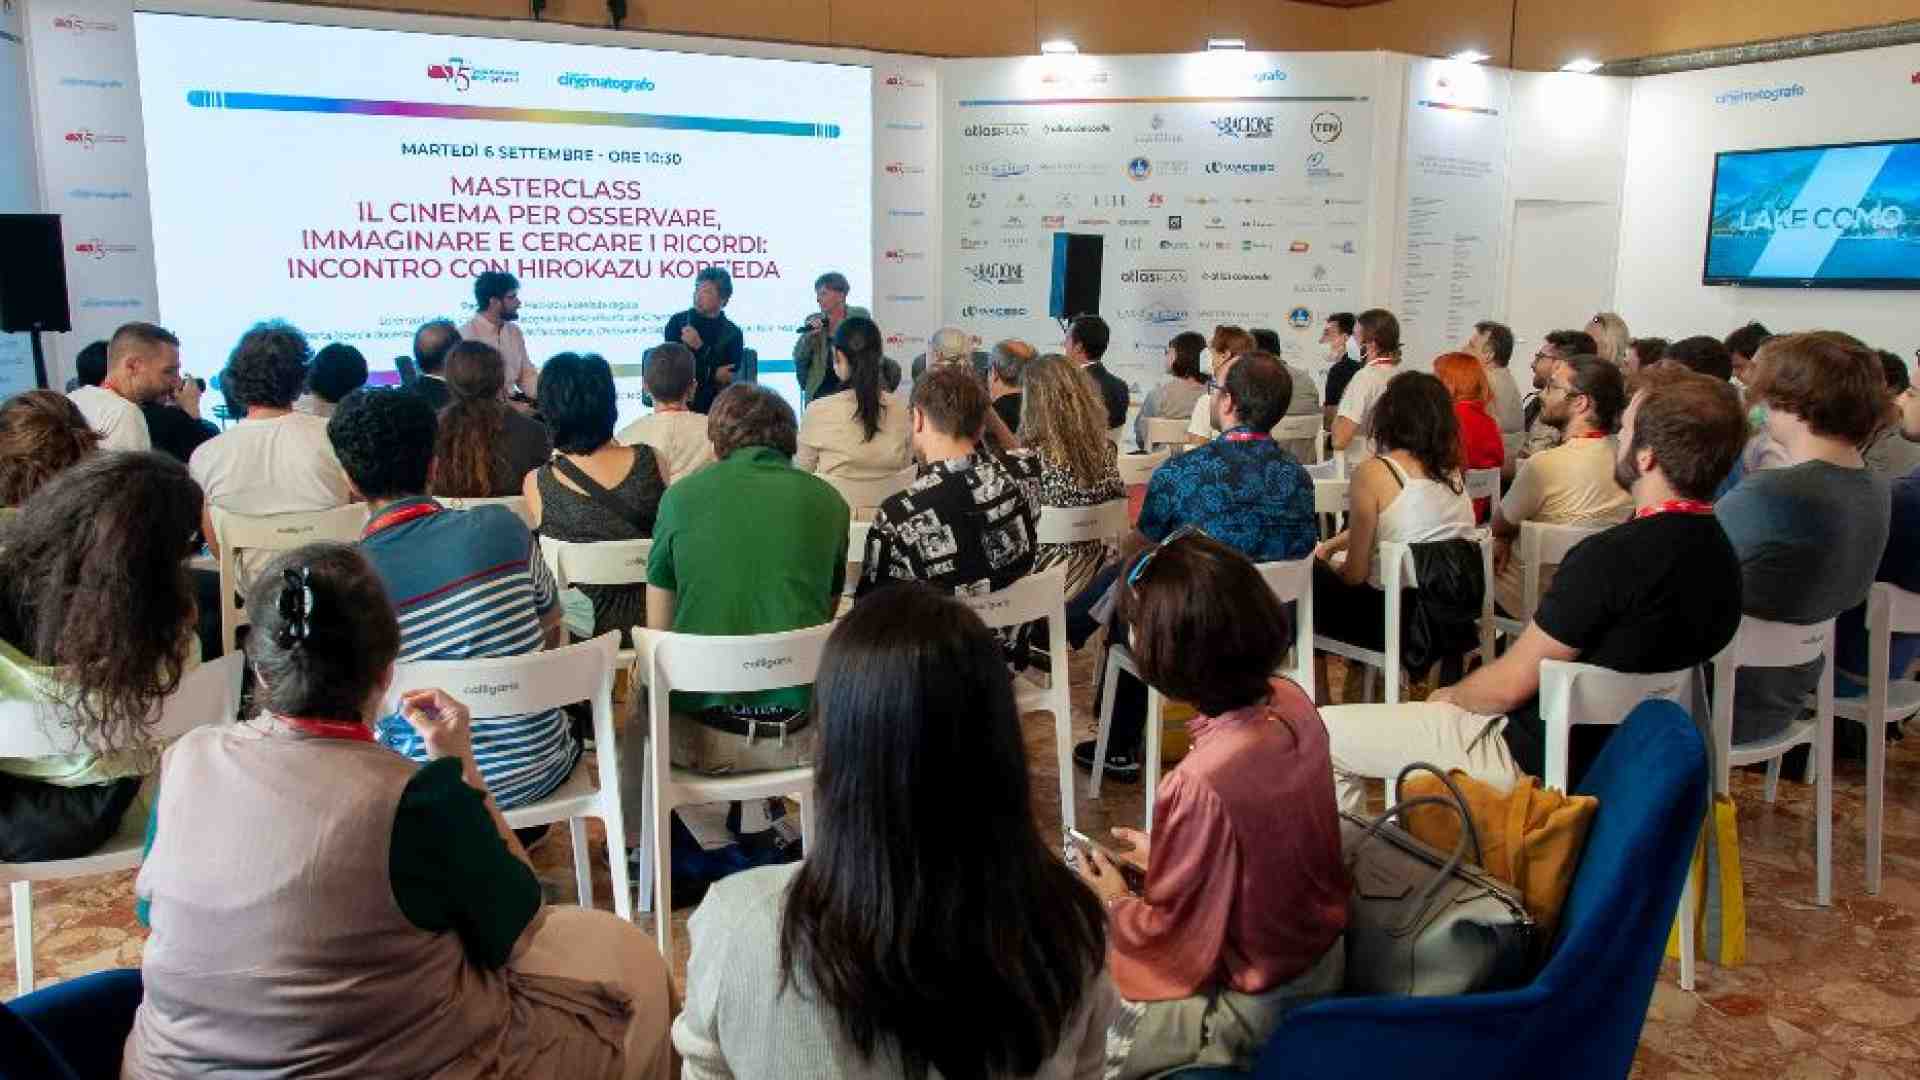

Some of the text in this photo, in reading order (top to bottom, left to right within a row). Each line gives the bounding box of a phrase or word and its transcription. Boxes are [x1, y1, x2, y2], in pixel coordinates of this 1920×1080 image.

[402, 143, 478, 157] MARTEDÌ
[484, 146, 495, 158] 6
[500, 146, 593, 161] SETTEMBRE
[608, 151, 641, 164] ORE
[645, 151, 682, 166] 10:30
[452, 176, 641, 201] MASTERCLASS
[358, 201, 721, 231] IL CINEMA PER OSSERVARE,
[1740, 204, 1905, 231] LAKE COMO
[302, 229, 490, 251] IMMAGINARE
[499, 232, 515, 251] E
[522, 232, 642, 251] CERCARE
[664, 234, 768, 254] RICORDI:
[288, 258, 443, 279] INCONTRO
[450, 258, 509, 278] CON
[518, 259, 651, 279] HIROKAZU
